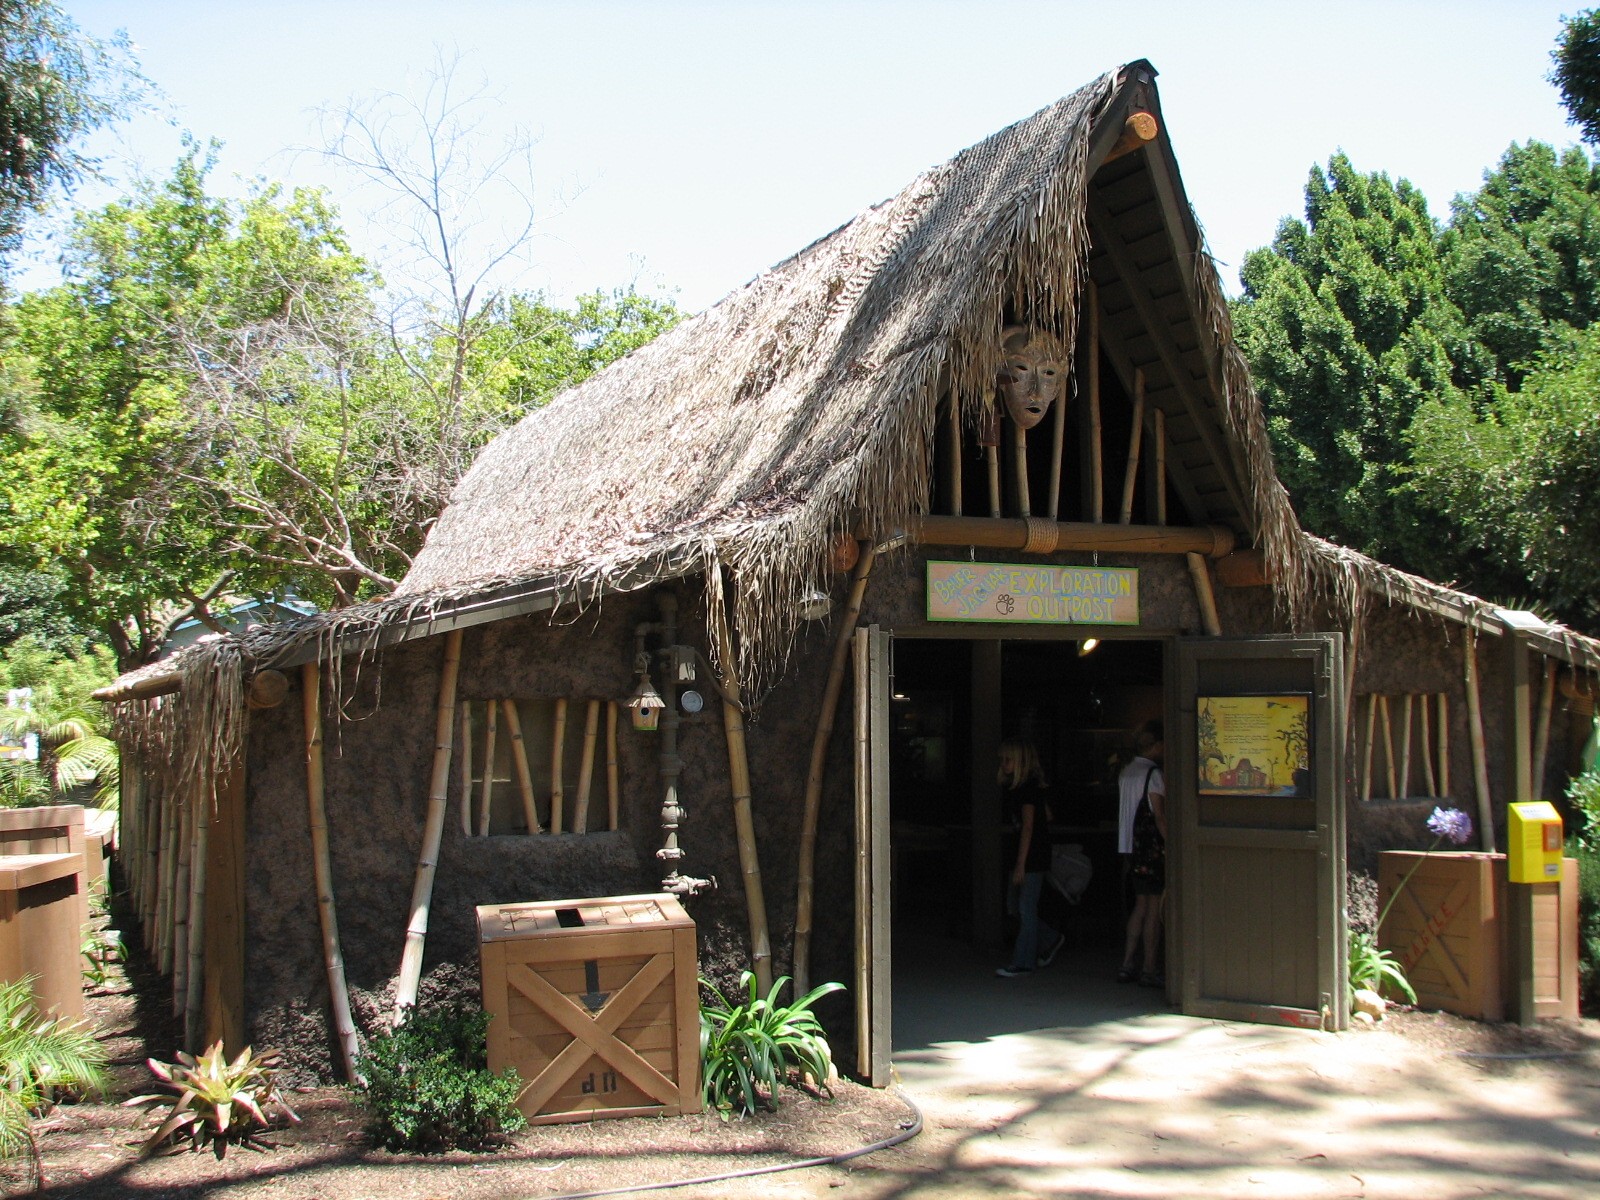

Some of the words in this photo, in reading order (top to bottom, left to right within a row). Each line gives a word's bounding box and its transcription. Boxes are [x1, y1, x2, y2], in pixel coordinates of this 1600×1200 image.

[958, 567, 1005, 615] JAGUAR
[1008, 570, 1132, 597] EXPLORATION
[1026, 594, 1115, 621] OUTPOST
